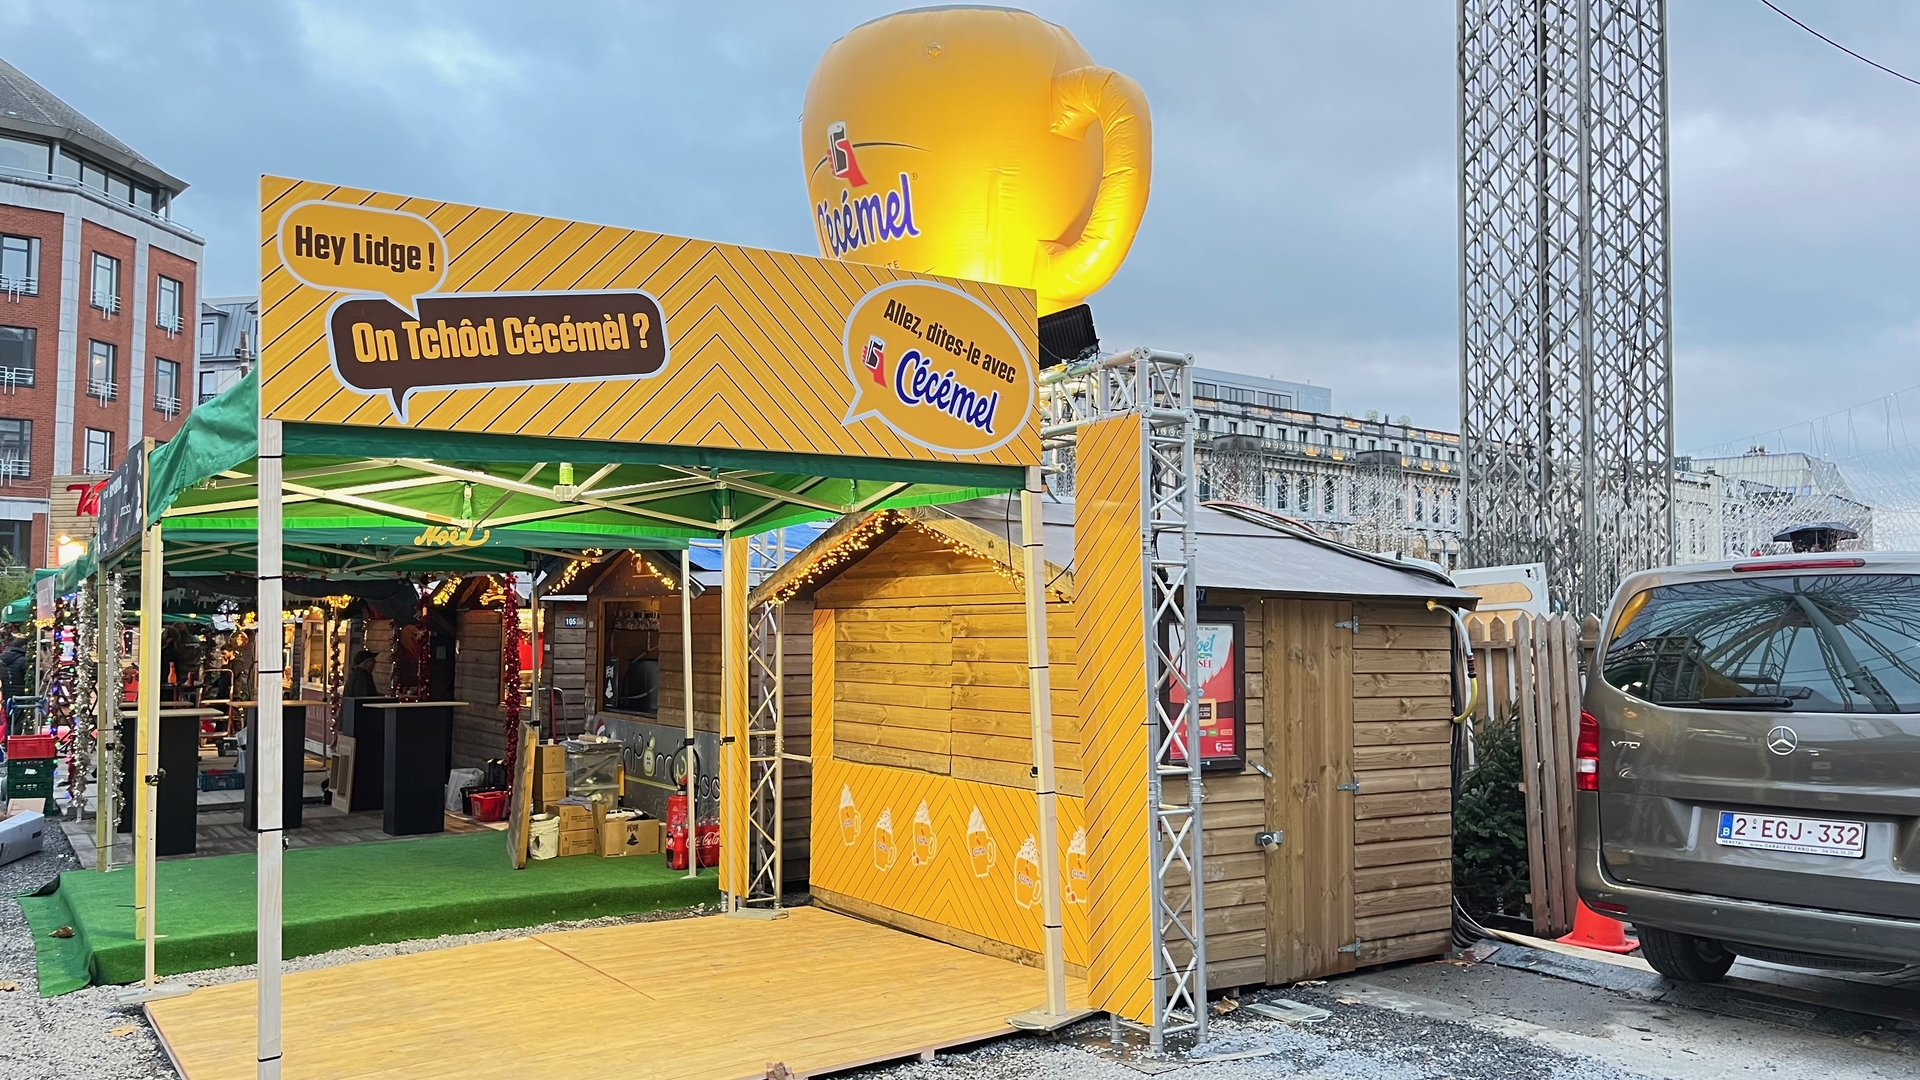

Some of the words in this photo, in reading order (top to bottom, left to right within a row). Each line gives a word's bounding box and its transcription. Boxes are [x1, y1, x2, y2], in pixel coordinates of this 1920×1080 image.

[294, 224, 346, 266] Hey
[352, 232, 422, 274] Lidge
[427, 242, 436, 273] !
[350, 321, 399, 363] On
[401, 316, 500, 361] Tchôd
[502, 314, 631, 357] Cécémèl
[632, 311, 652, 350] ?
[883, 298, 923, 339] Allez,
[926, 321, 981, 366] dites-le
[981, 352, 1017, 384] avec
[894, 348, 999, 435] Cécémel
[565, 617, 578, 626] 105
[1197, 633, 1216, 652] oël
[1611, 740, 1641, 749] VITO
[1722, 827, 1730, 836] B
